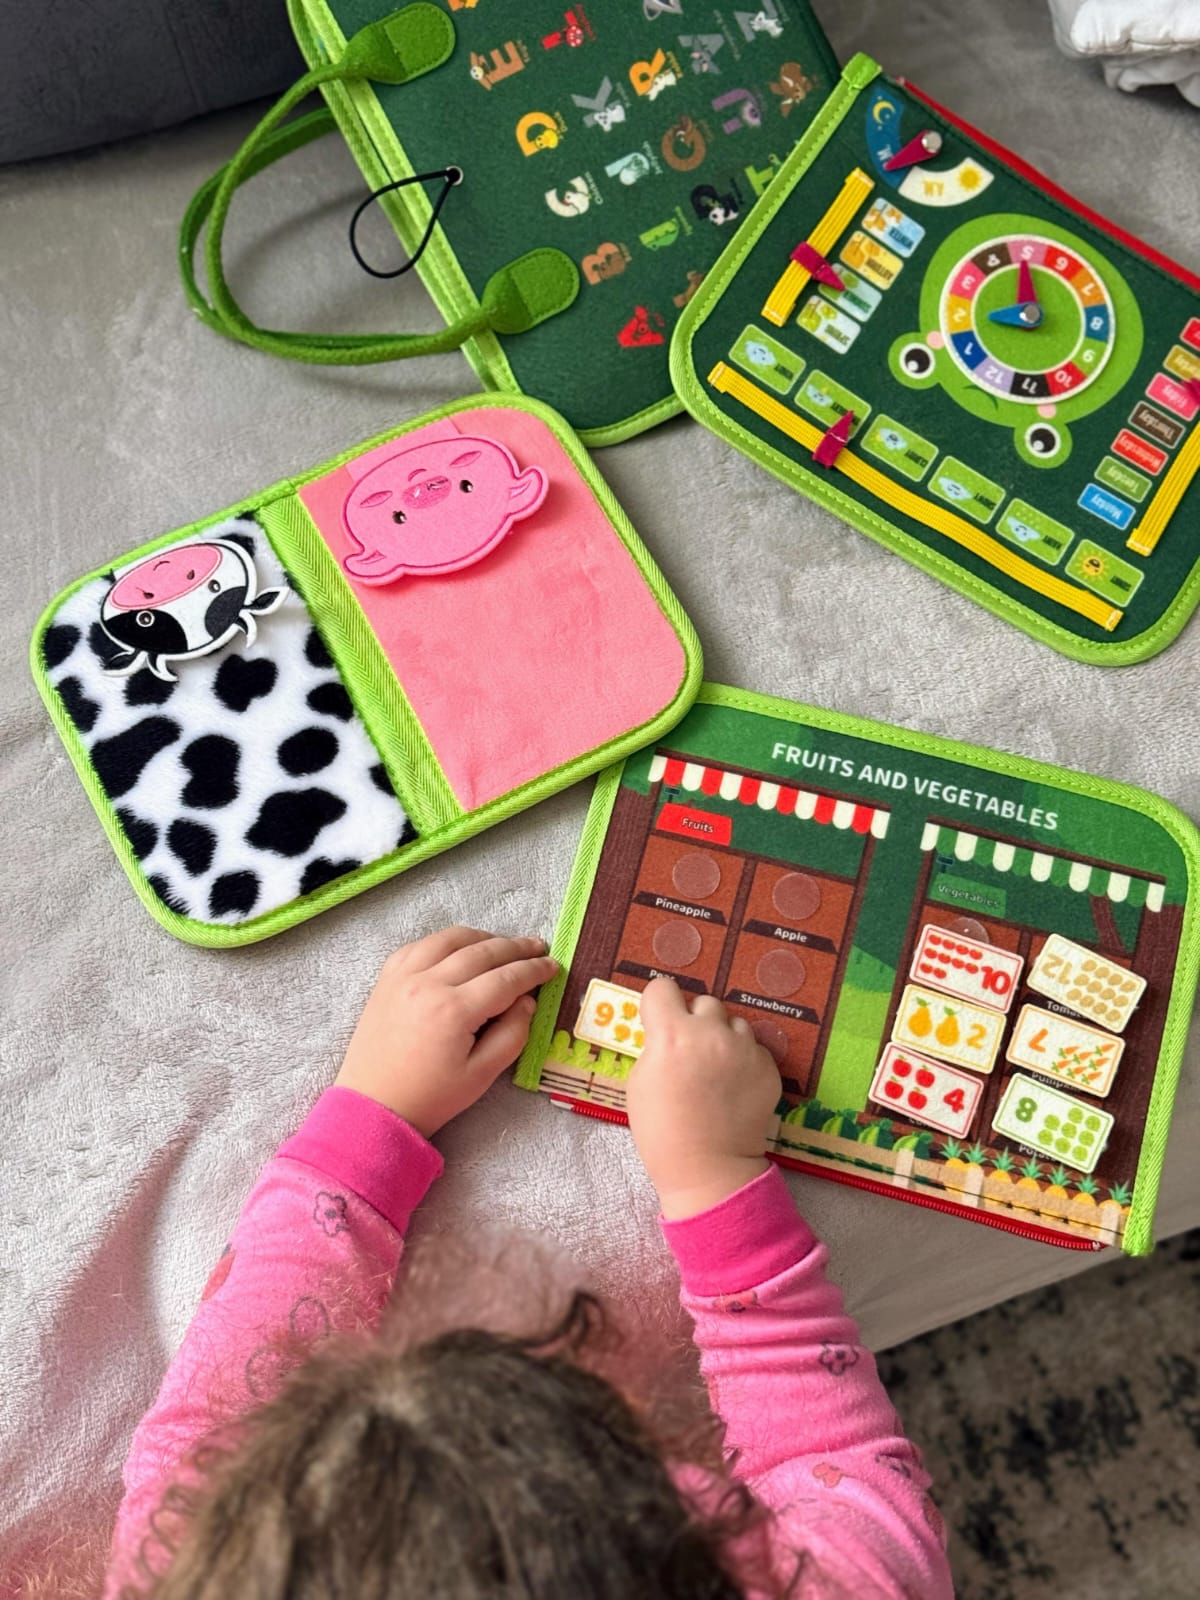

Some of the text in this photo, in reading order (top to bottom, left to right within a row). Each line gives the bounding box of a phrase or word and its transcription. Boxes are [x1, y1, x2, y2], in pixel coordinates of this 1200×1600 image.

[481, 41, 525, 86] E
[629, 48, 666, 96] R
[571, 76, 613, 128] K
[516, 112, 558, 157] D
[545, 176, 589, 217] C
[582, 243, 625, 285] B
[988, 253, 1000, 267] 4
[1021, 246, 1034, 260] 5
[960, 276, 974, 290] 3
[1082, 282, 1096, 296] 7
[617, 306, 664, 348] A
[952, 307, 967, 322] 2
[1091, 317, 1103, 330] 8
[963, 342, 974, 355] 1
[985, 366, 1004, 384] 12
[1021, 376, 1038, 394] 11
[1055, 370, 1073, 387] 10
[1088, 491, 1124, 520] Monday
[770, 741, 1060, 831] FRUITS AND VEGETABLES
[681, 816, 715, 833] Fruits
[654, 896, 712, 920] Pineapple
[936, 884, 1000, 908] Vegetables
[773, 926, 807, 944] Apple
[981, 966, 1011, 995] 10
[1042, 954, 1073, 985] 12
[738, 992, 803, 1018] Strawberry
[966, 1024, 986, 1049] 2
[943, 1088, 966, 1113] 4
[1015, 1097, 1038, 1123] 8
